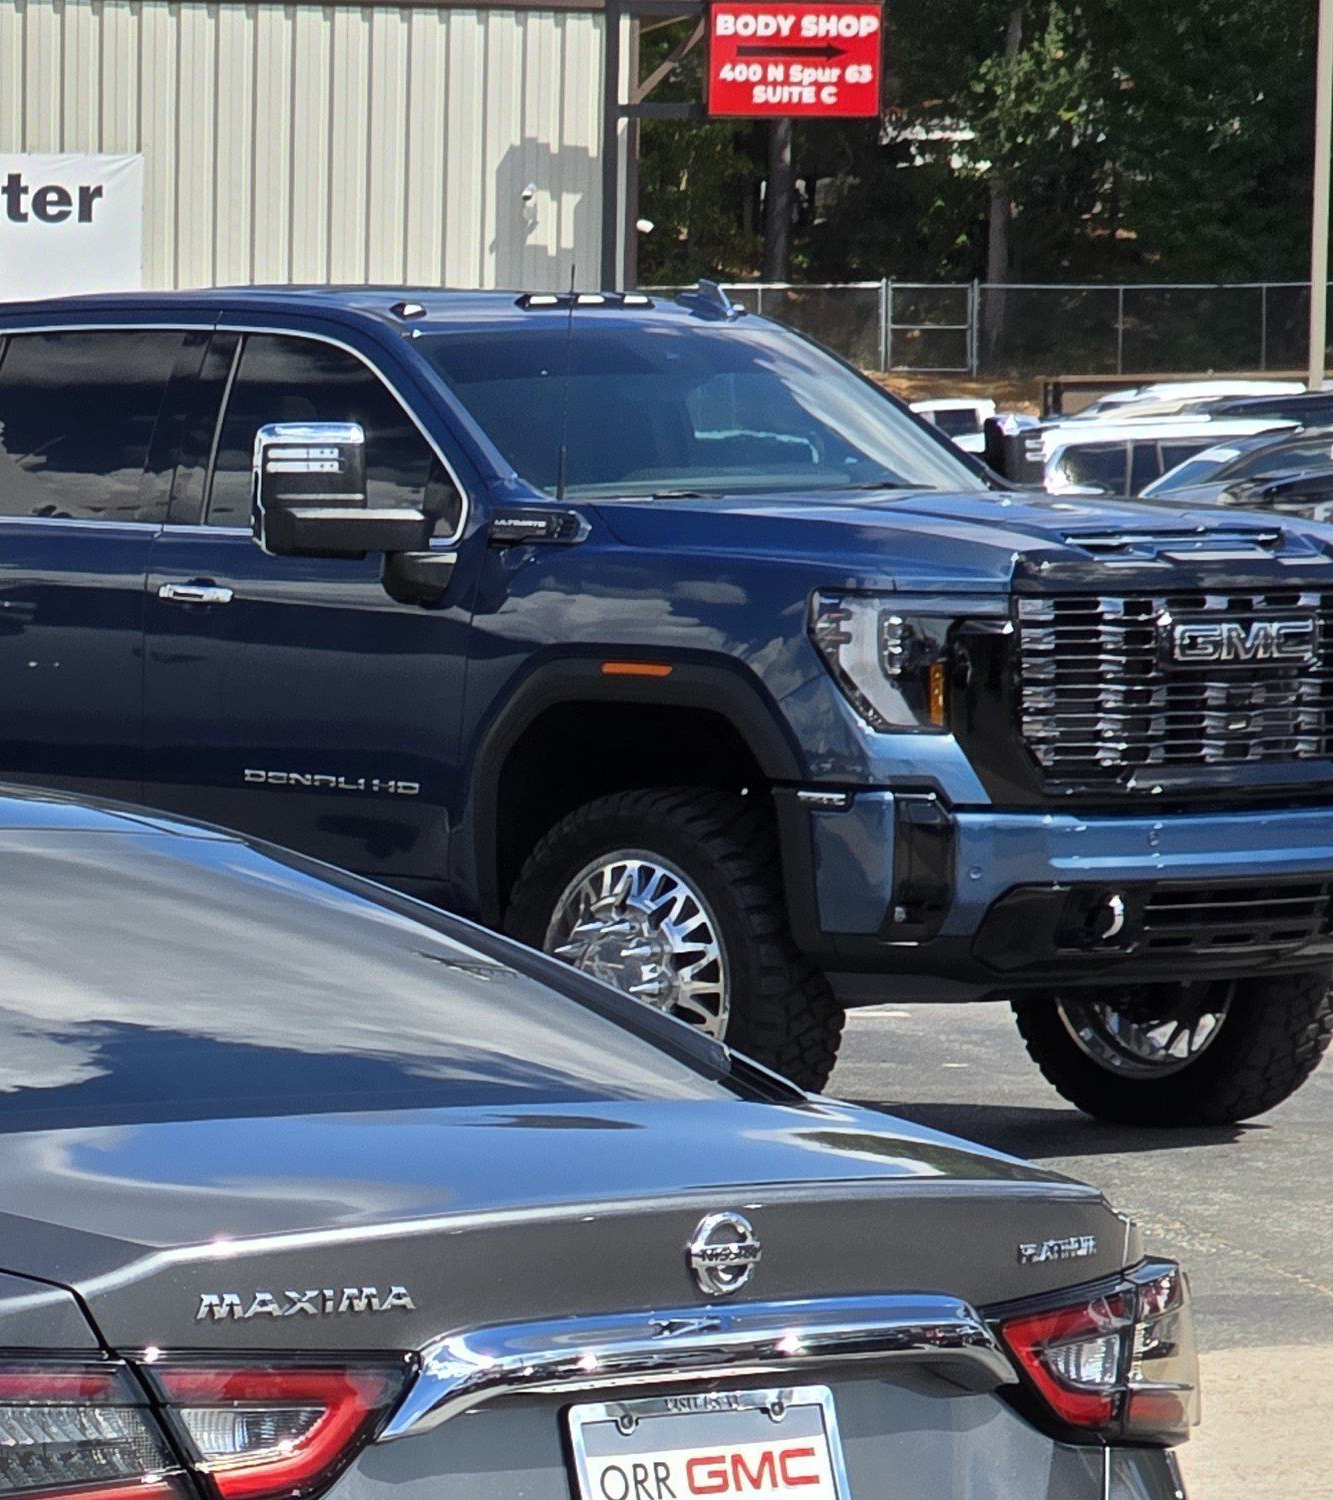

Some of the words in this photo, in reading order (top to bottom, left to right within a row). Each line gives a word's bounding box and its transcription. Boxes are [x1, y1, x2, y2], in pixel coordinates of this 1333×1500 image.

[716, 14, 796, 37] BODY
[800, 15, 880, 37] SHOP
[719, 63, 763, 82] 400
[767, 64, 784, 82] N
[789, 64, 841, 86] Spur
[844, 64, 873, 83] 63
[752, 85, 816, 104] SUITE
[820, 86, 838, 105] C
[1174, 619, 1313, 661] GMC
[244, 768, 365, 790] DENALI
[371, 779, 420, 795] HD
[196, 1285, 417, 1322] MAXIMA
[686, 1447, 820, 1495] GMC
